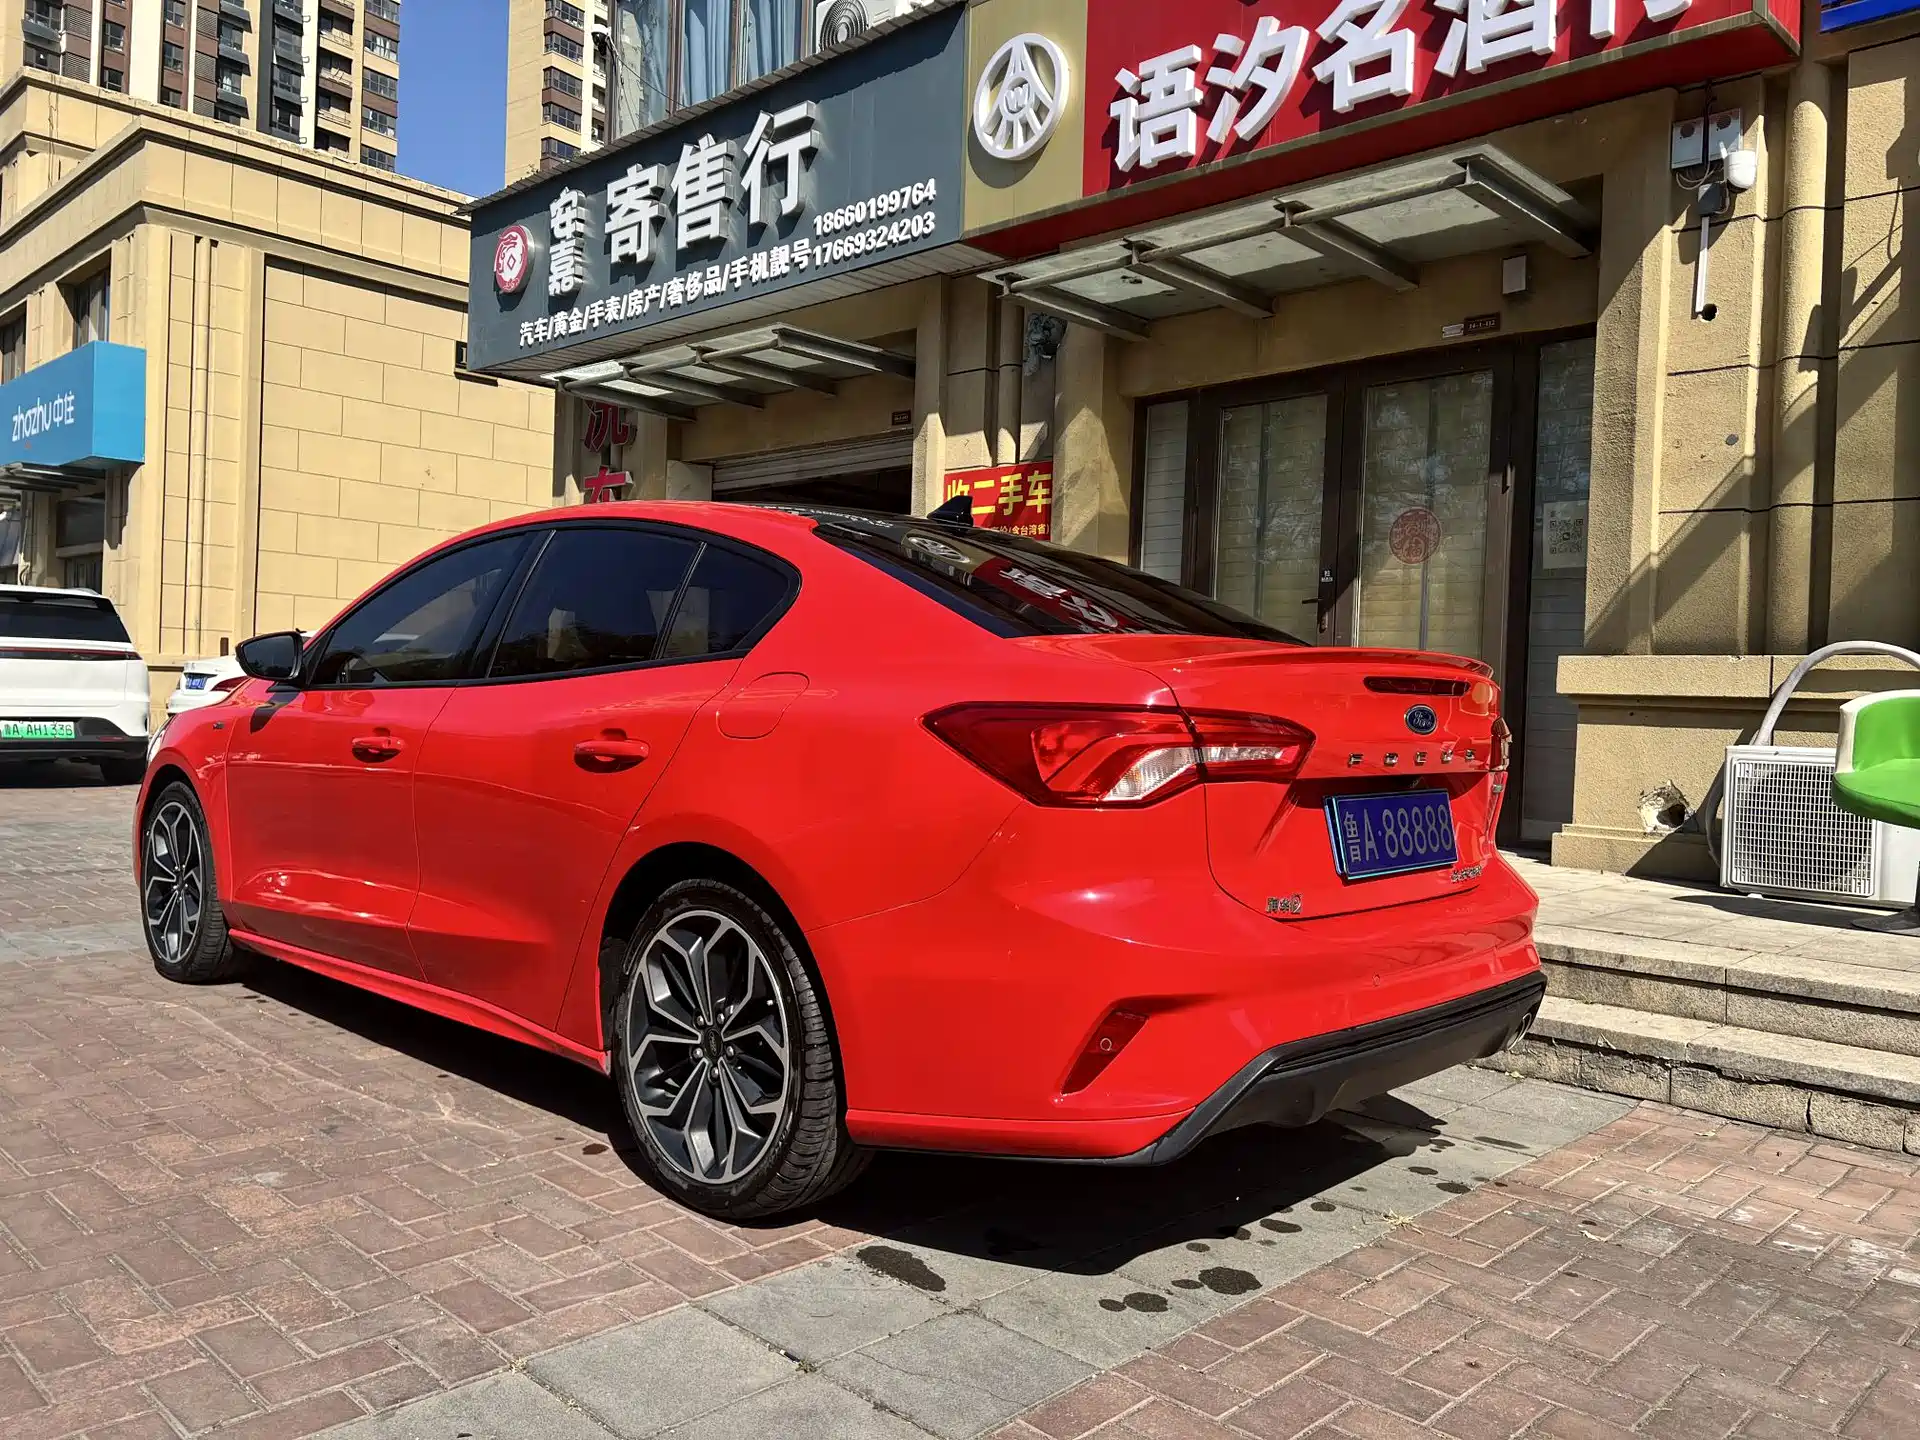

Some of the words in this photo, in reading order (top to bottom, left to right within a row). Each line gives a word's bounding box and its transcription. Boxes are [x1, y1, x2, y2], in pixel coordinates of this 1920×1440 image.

[1110, 0, 1692, 172] 语汐名酒
[605, 100, 819, 264] 寄售行
[814, 178, 936, 236] 18660199764
[549, 186, 586, 296] 安嘉
[813, 211, 936, 267] 17669324203
[53, 389, 75, 427] 中住
